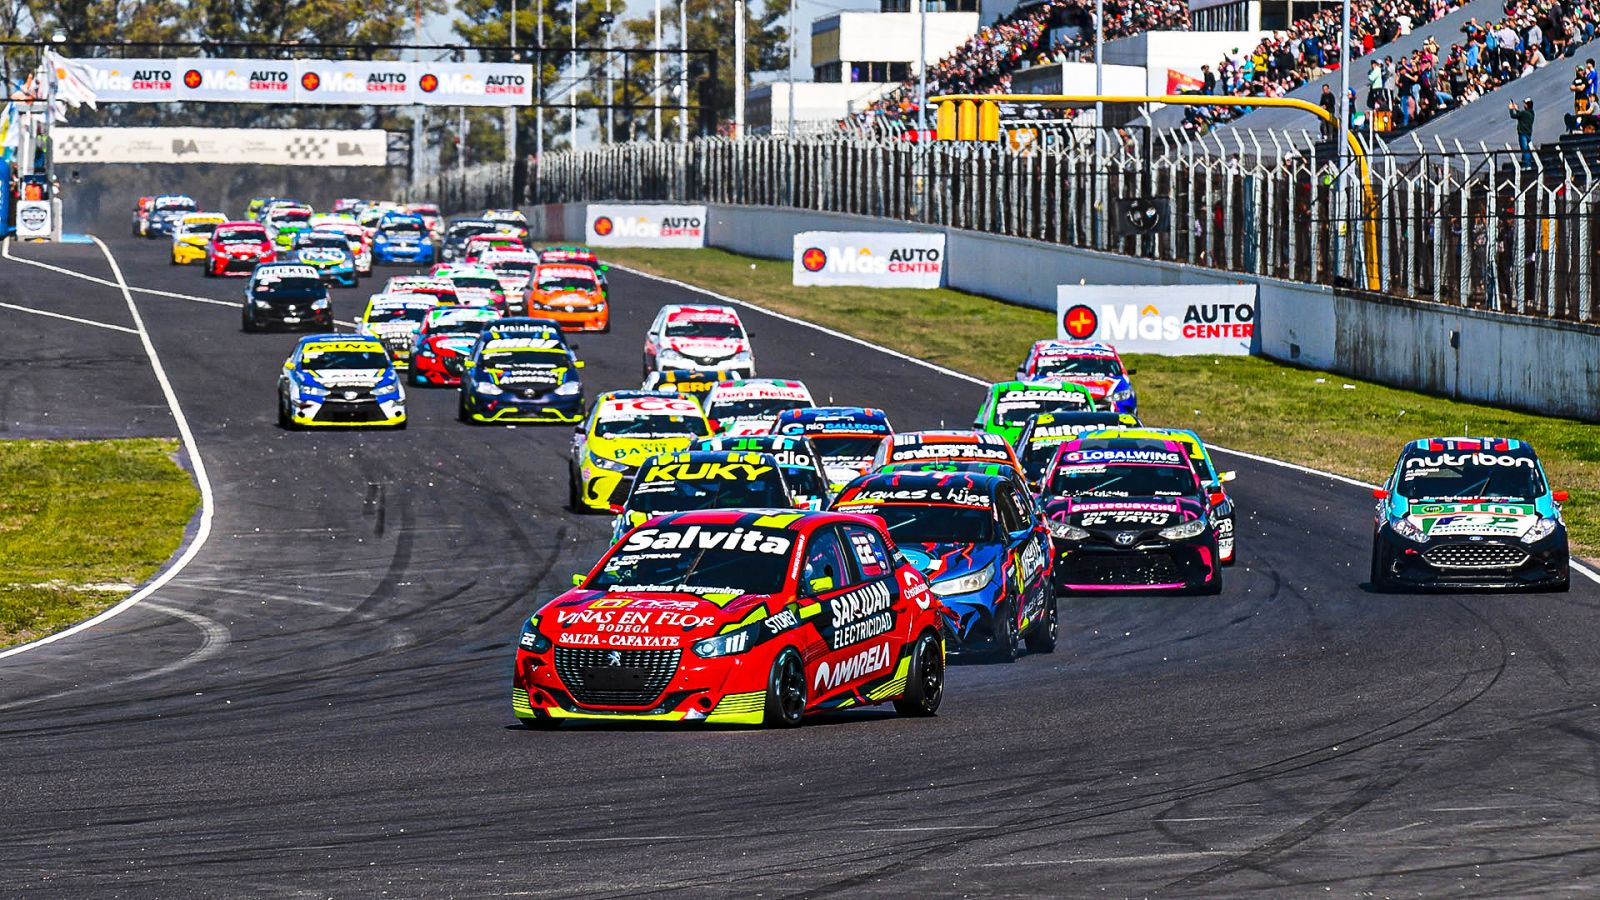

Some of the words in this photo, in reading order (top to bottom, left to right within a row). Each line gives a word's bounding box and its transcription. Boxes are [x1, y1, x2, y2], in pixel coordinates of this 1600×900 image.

[132, 70, 171, 81] AUTO
[250, 71, 288, 82] AUTO
[367, 73, 406, 84] AUTO
[486, 75, 525, 86] AUTO
[132, 80, 172, 90] CENTER
[249, 81, 288, 91] CENTER
[366, 83, 406, 92] CENTER
[485, 85, 525, 94] CENTER
[661, 216, 701, 229] AUTO
[660, 228, 701, 237] CENTER
[889, 248, 940, 262] AUTO
[888, 262, 940, 273] CENTER
[1183, 304, 1255, 323] AUTO
[1183, 323, 1255, 338] CENTER
[607, 401, 696, 411] TCG
[825, 423, 885, 431] GALLEGOS
[775, 450, 810, 466] dio
[1066, 450, 1180, 462] GLOBALWING
[1406, 452, 1535, 468] nutribon
[645, 463, 773, 482] KUKY
[946, 487, 990, 504] hijos
[1111, 515, 1169, 526] TATU
[622, 525, 791, 555] Salvita
[608, 583, 673, 593] Parabrisas
[676, 584, 745, 596] Pergamino
[556, 609, 617, 624] VIÑAS
[618, 611, 653, 624] EN
[654, 612, 715, 627] FLOR
[764, 609, 798, 634] STOREY
[597, 624, 649, 633] BODEGA
[833, 612, 892, 649] ELECTRICIDAD
[559, 633, 600, 645] SALTA
[608, 634, 680, 647] CAFAYATE
[828, 642, 890, 690] AMARELA
